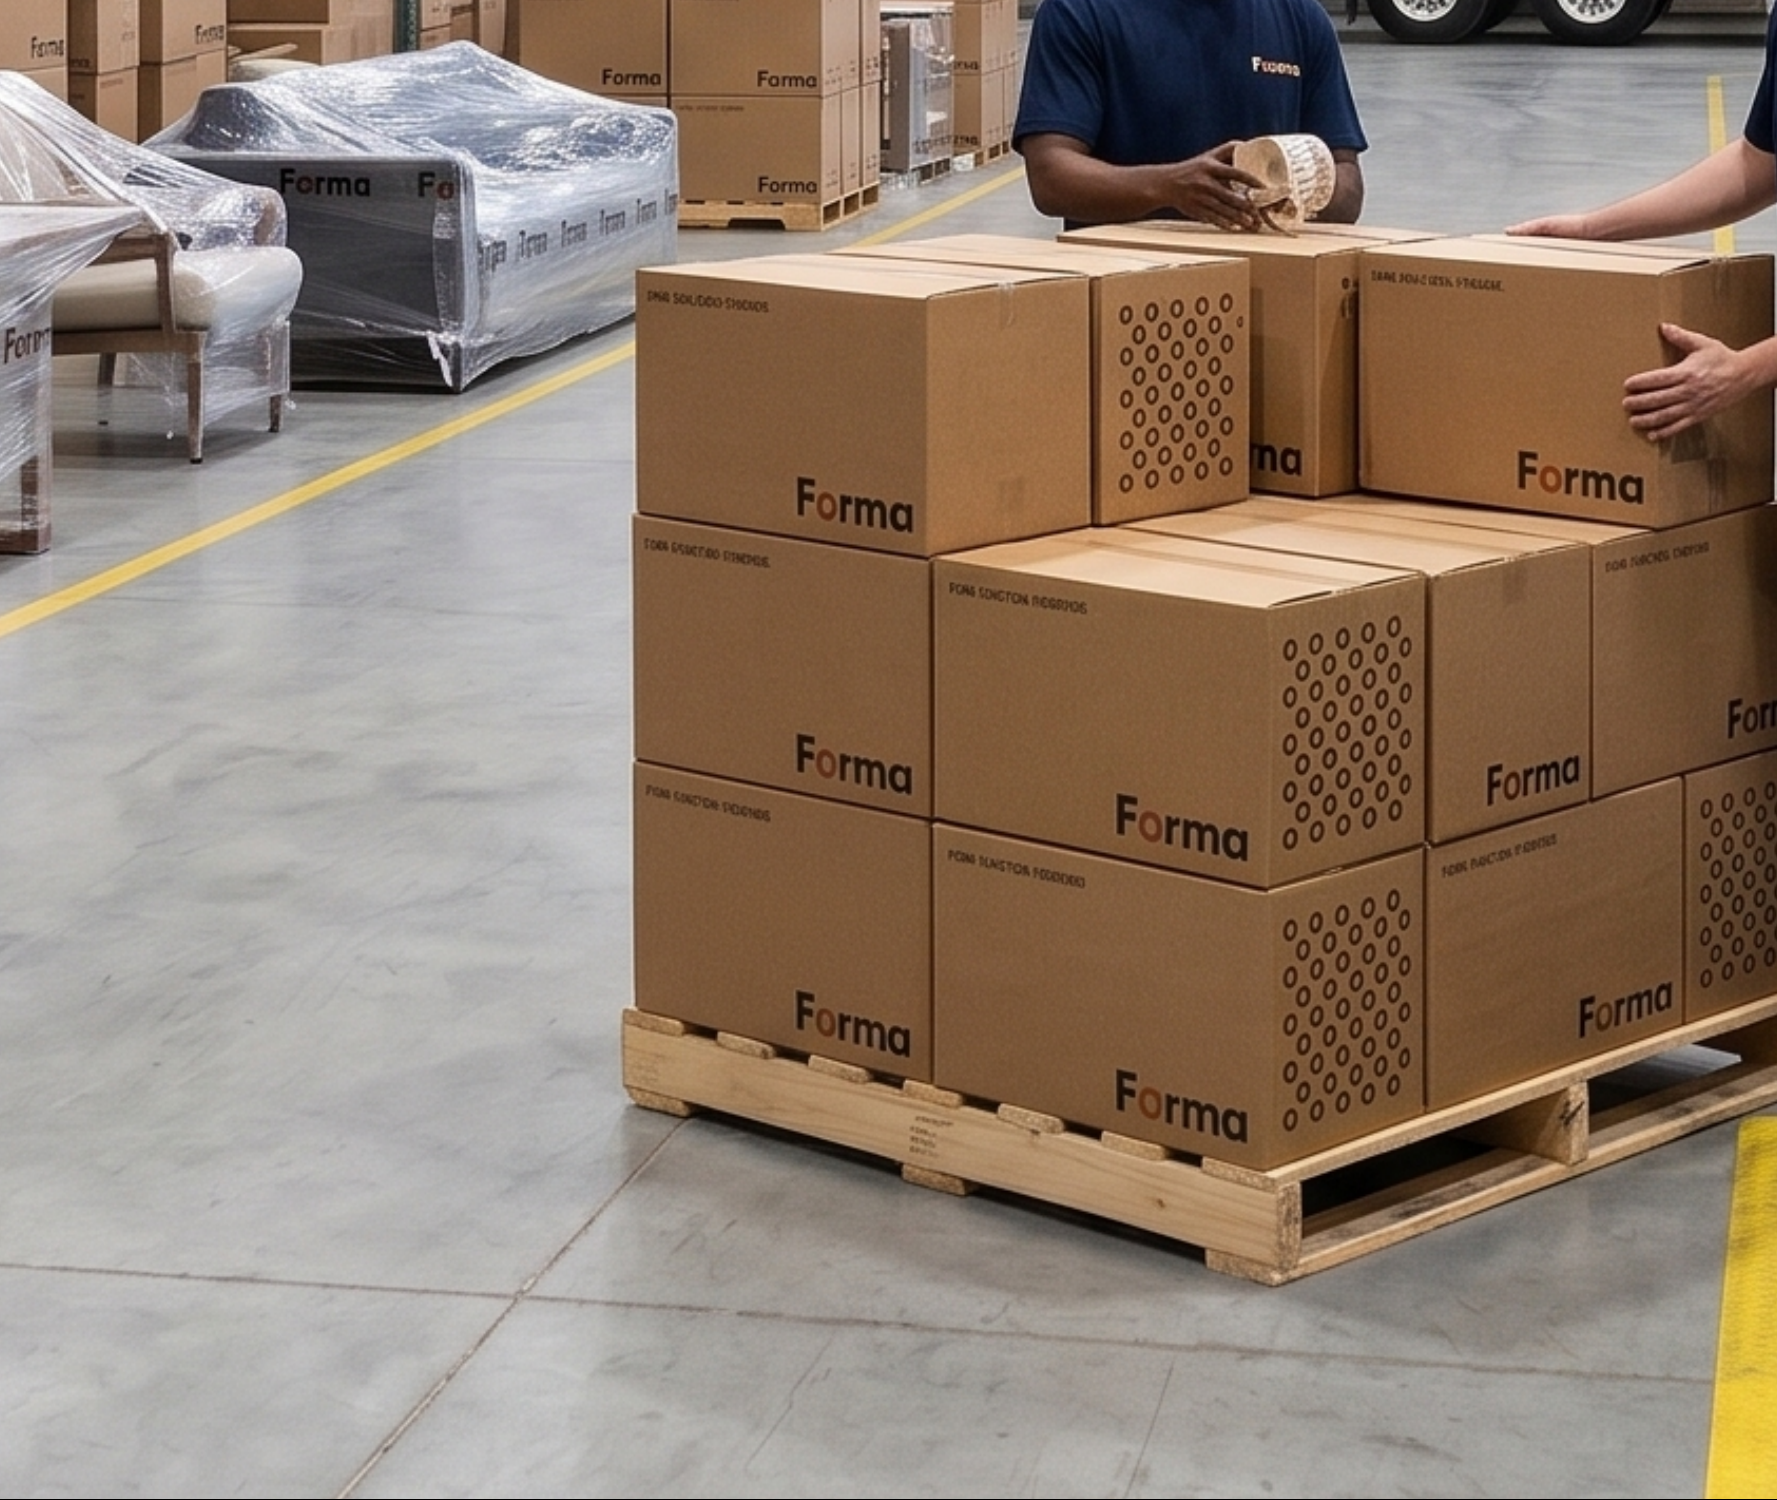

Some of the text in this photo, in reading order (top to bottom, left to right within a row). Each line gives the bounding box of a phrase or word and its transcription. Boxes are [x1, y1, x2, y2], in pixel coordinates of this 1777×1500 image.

[602, 69, 661, 86] Forma
[279, 169, 370, 197] Forma
[758, 177, 817, 194] Forma
[797, 477, 914, 533] Forma
[1517, 451, 1644, 504] Forma
[797, 733, 912, 794] Forma
[1487, 755, 1579, 805] Forma
[1116, 793, 1248, 862] Forma
[796, 990, 910, 1057] Forma
[1578, 980, 1672, 1037] Forma
[1116, 1069, 1248, 1143] Forma
